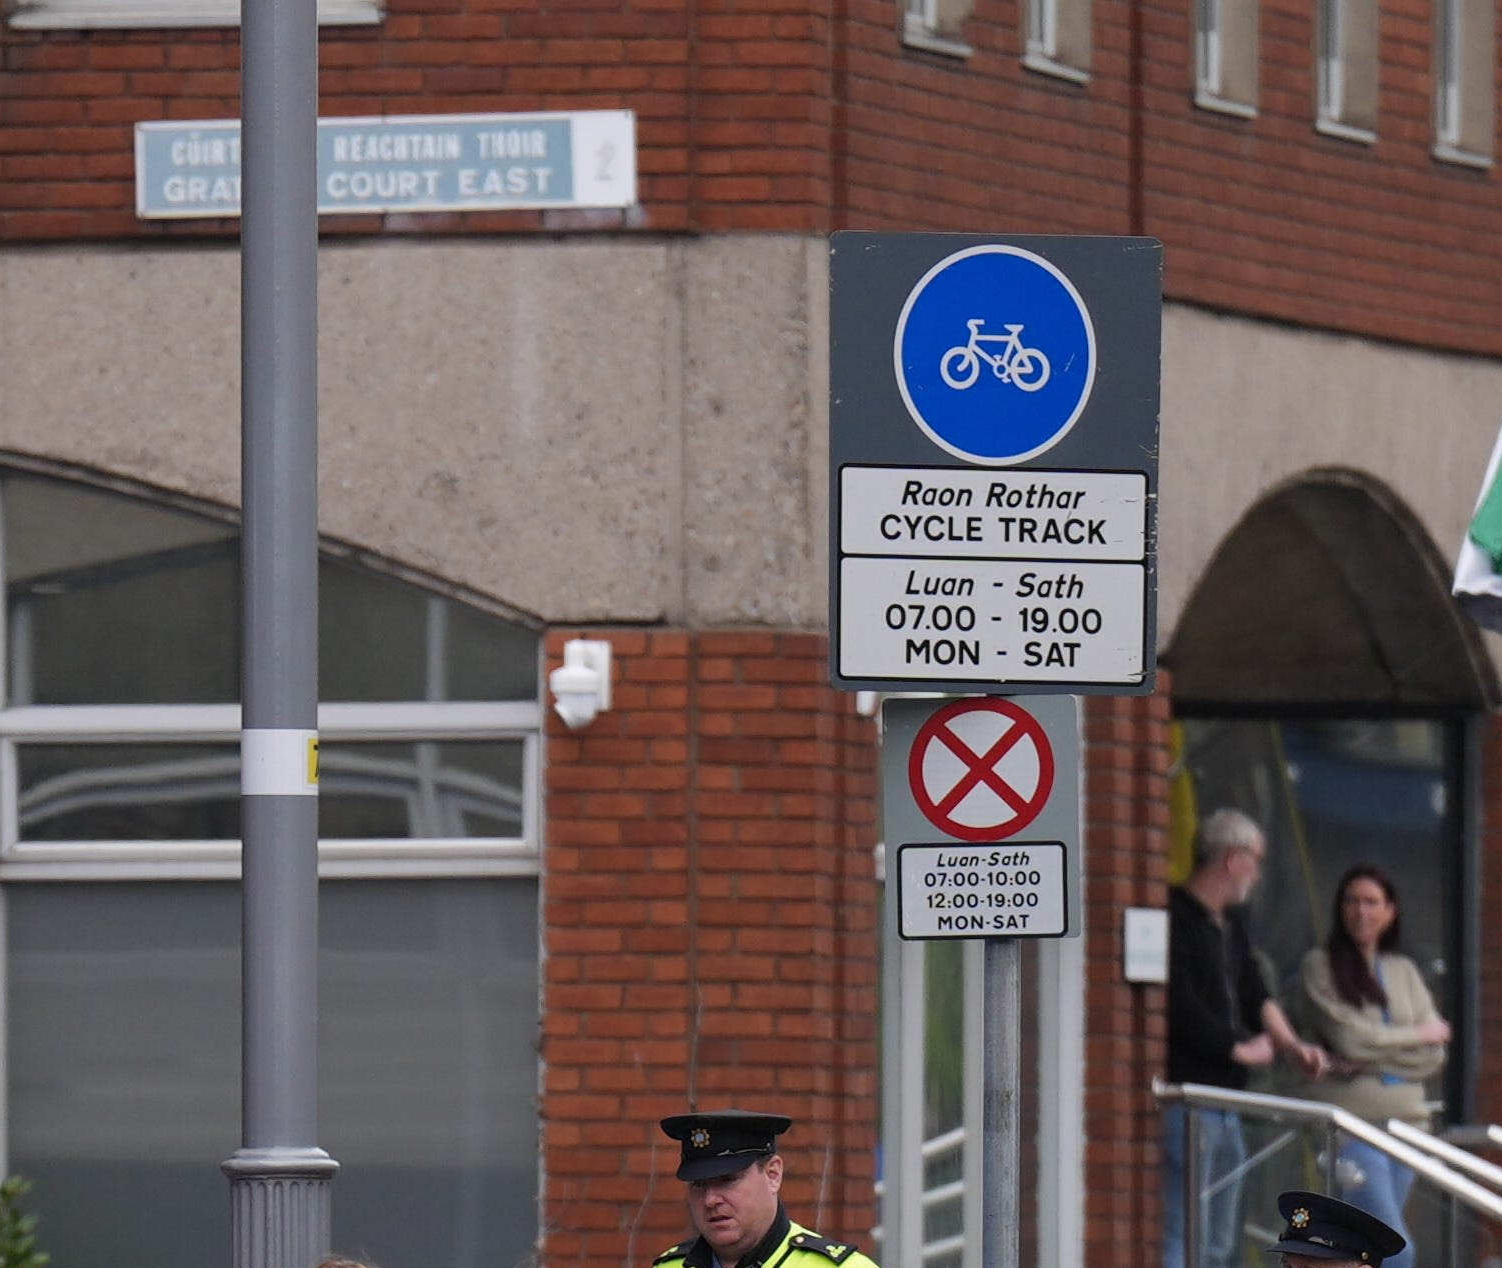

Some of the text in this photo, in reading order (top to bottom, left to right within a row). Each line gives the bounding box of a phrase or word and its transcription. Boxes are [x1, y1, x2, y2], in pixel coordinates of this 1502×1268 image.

[333, 132, 461, 163] REACHTAIN
[477, 129, 546, 160] THOIR
[326, 169, 443, 199] COURT
[458, 166, 553, 196] EAST
[901, 480, 1086, 510] Raon Rothar
[880, 513, 1107, 545] CYCLE TRACK
[905, 569, 975, 597] Luan
[1015, 572, 1084, 599] Sath
[885, 603, 976, 632] 07.00
[1018, 607, 1102, 635] 19.00
[905, 638, 980, 666] MON
[1023, 641, 1082, 668] SAT
[936, 851, 1030, 868] Luan-Sath
[924, 870, 1041, 888] 07:00-10:00
[926, 892, 1039, 909] 12:00-19:00
[937, 914, 1030, 931] MON-SAT
